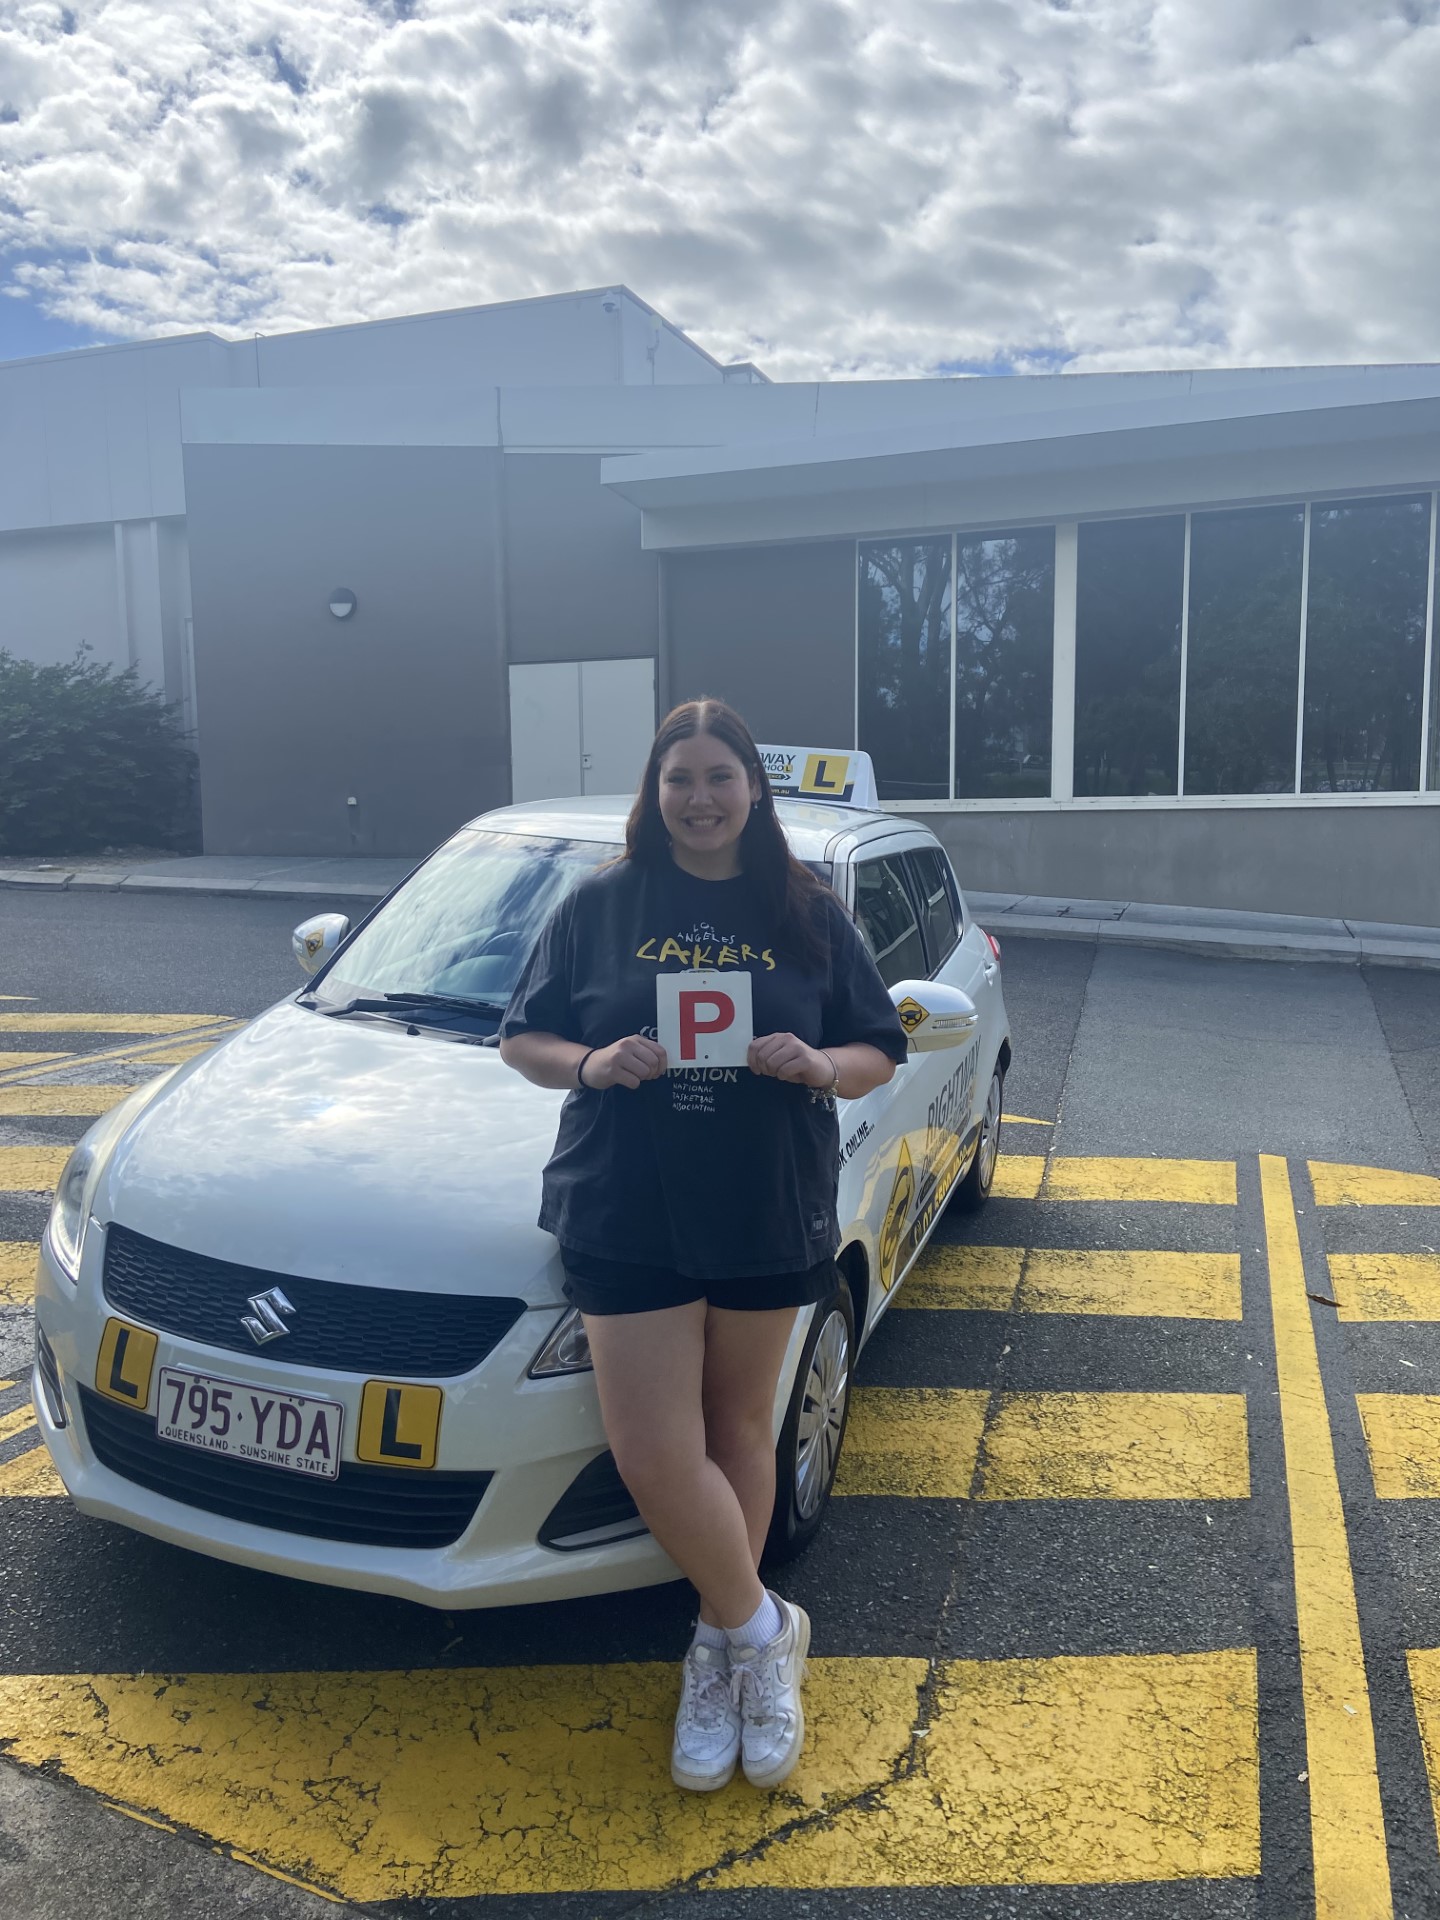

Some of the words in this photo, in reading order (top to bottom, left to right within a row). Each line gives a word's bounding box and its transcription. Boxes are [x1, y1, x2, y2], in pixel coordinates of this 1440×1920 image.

[814, 760, 836, 788] L
[636, 937, 776, 970] LAKERS
[677, 931, 736, 945] ANGELES
[679, 990, 735, 1060] P
[109, 1328, 139, 1400] L
[379, 1387, 422, 1460] L
[165, 1426, 229, 1450] QUEENSLAND
[239, 1444, 291, 1466] SUNSHINE
[296, 1457, 328, 1473] STATE
